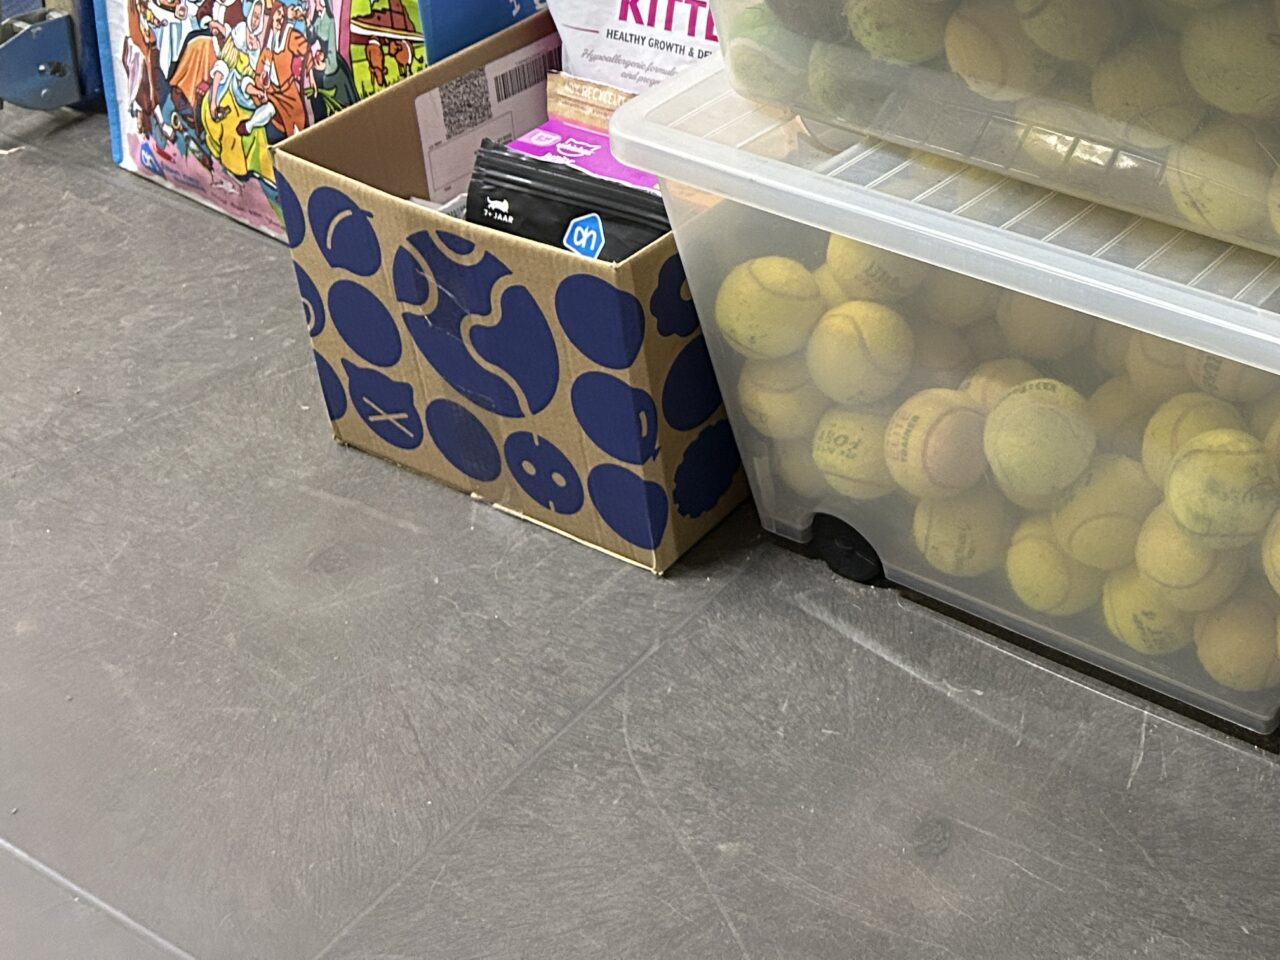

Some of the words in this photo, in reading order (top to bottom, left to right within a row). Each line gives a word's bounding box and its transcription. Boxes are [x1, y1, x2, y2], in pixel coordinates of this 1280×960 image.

[606, 28, 647, 46] HEALTHY
[648, 37, 686, 56] GROWTH
[688, 47, 695, 58] &
[697, 48, 714, 60] DE
[493, 211, 514, 225] JAAR
